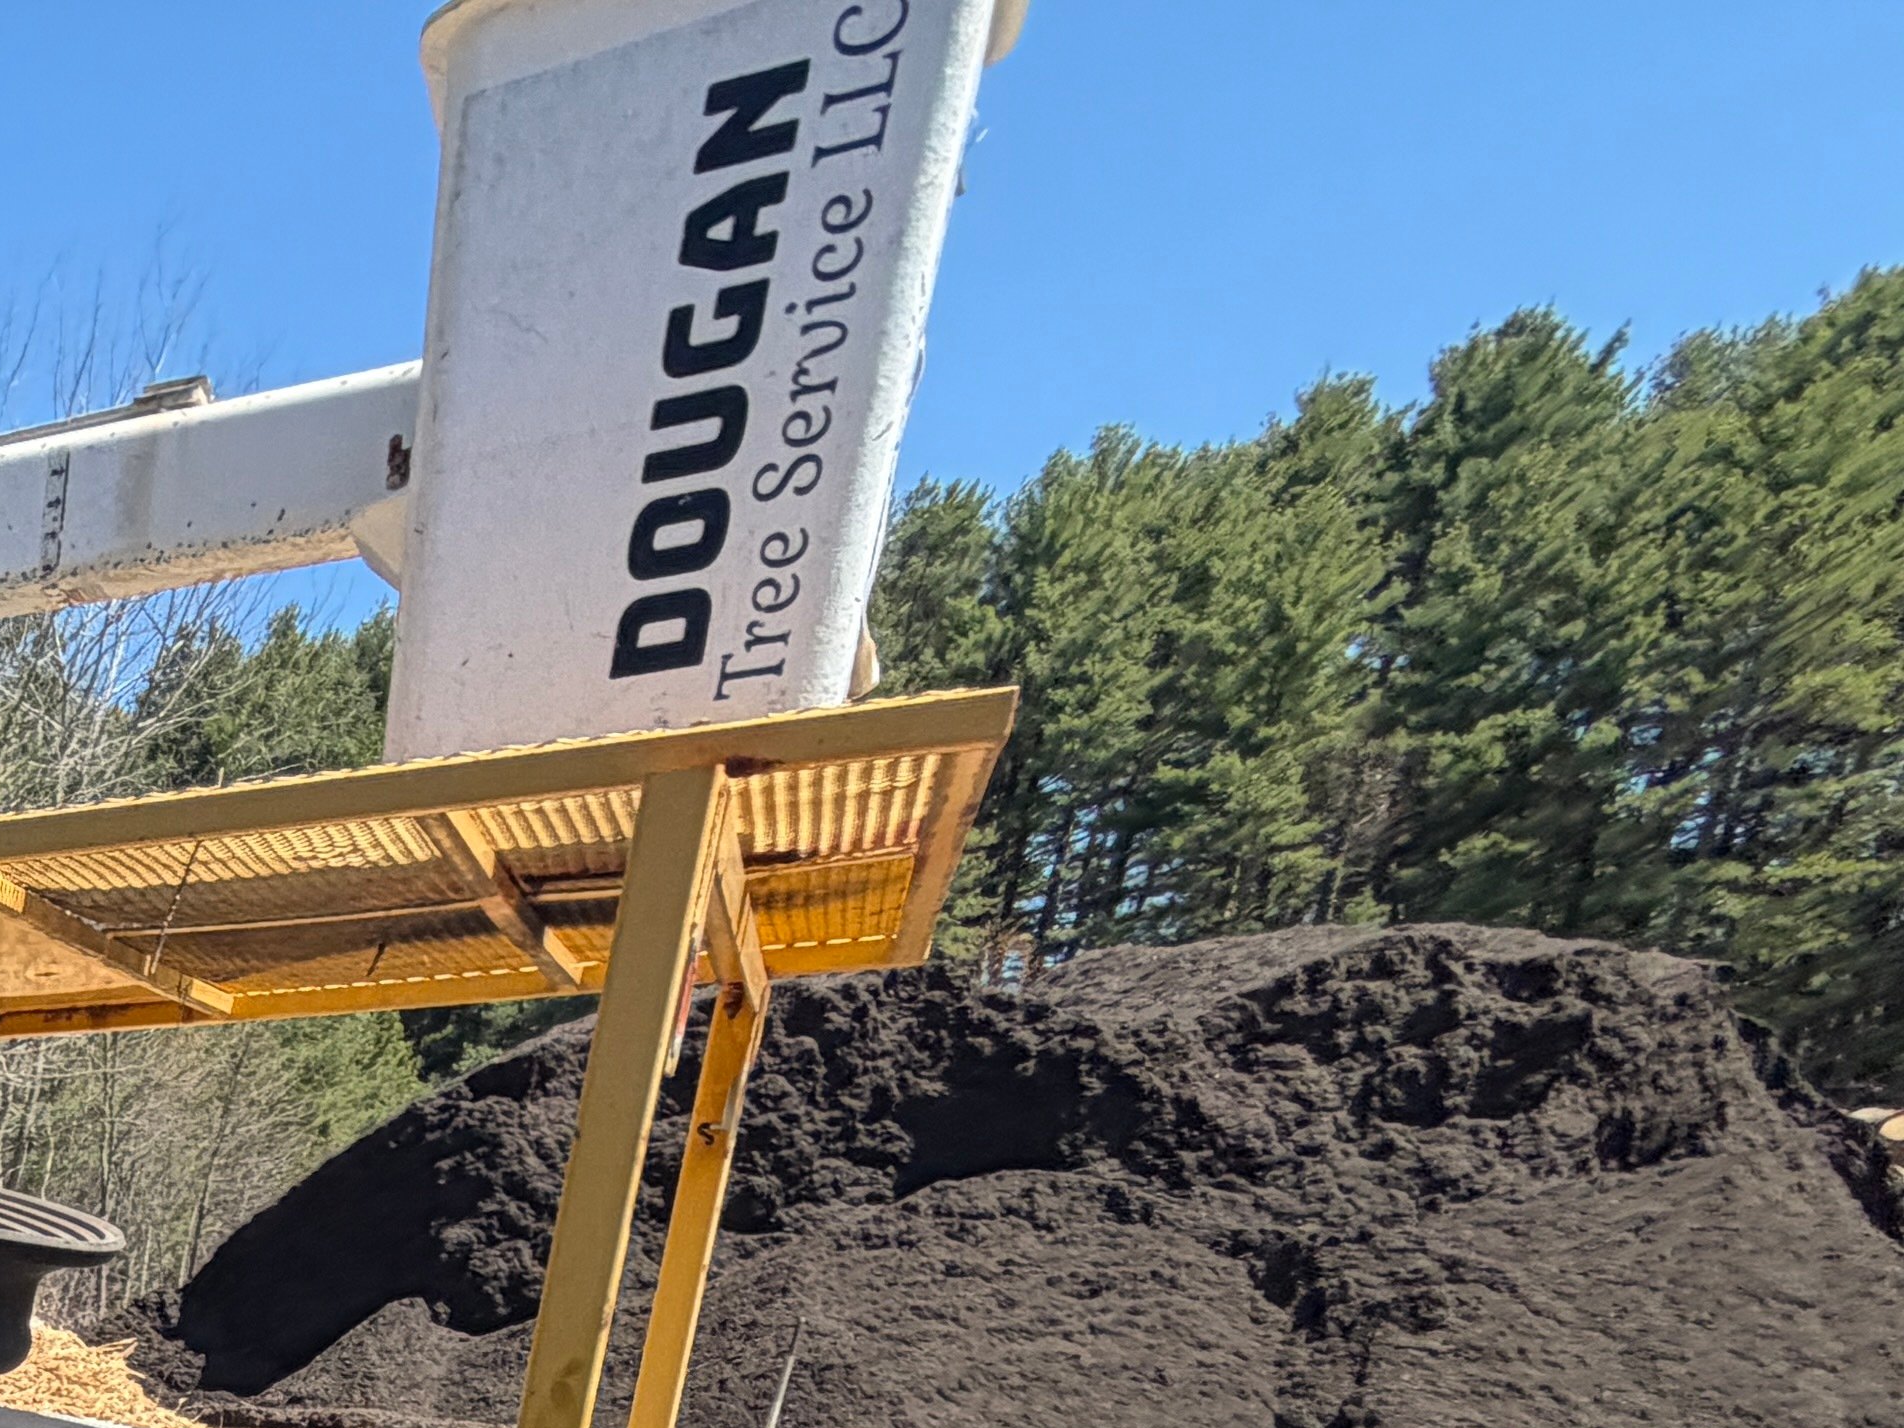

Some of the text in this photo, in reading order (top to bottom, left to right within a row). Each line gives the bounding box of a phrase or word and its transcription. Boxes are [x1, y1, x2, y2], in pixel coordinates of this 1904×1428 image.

[609, 57, 811, 679] DOUGAN
[713, 0, 909, 701] Tree Service LLC
